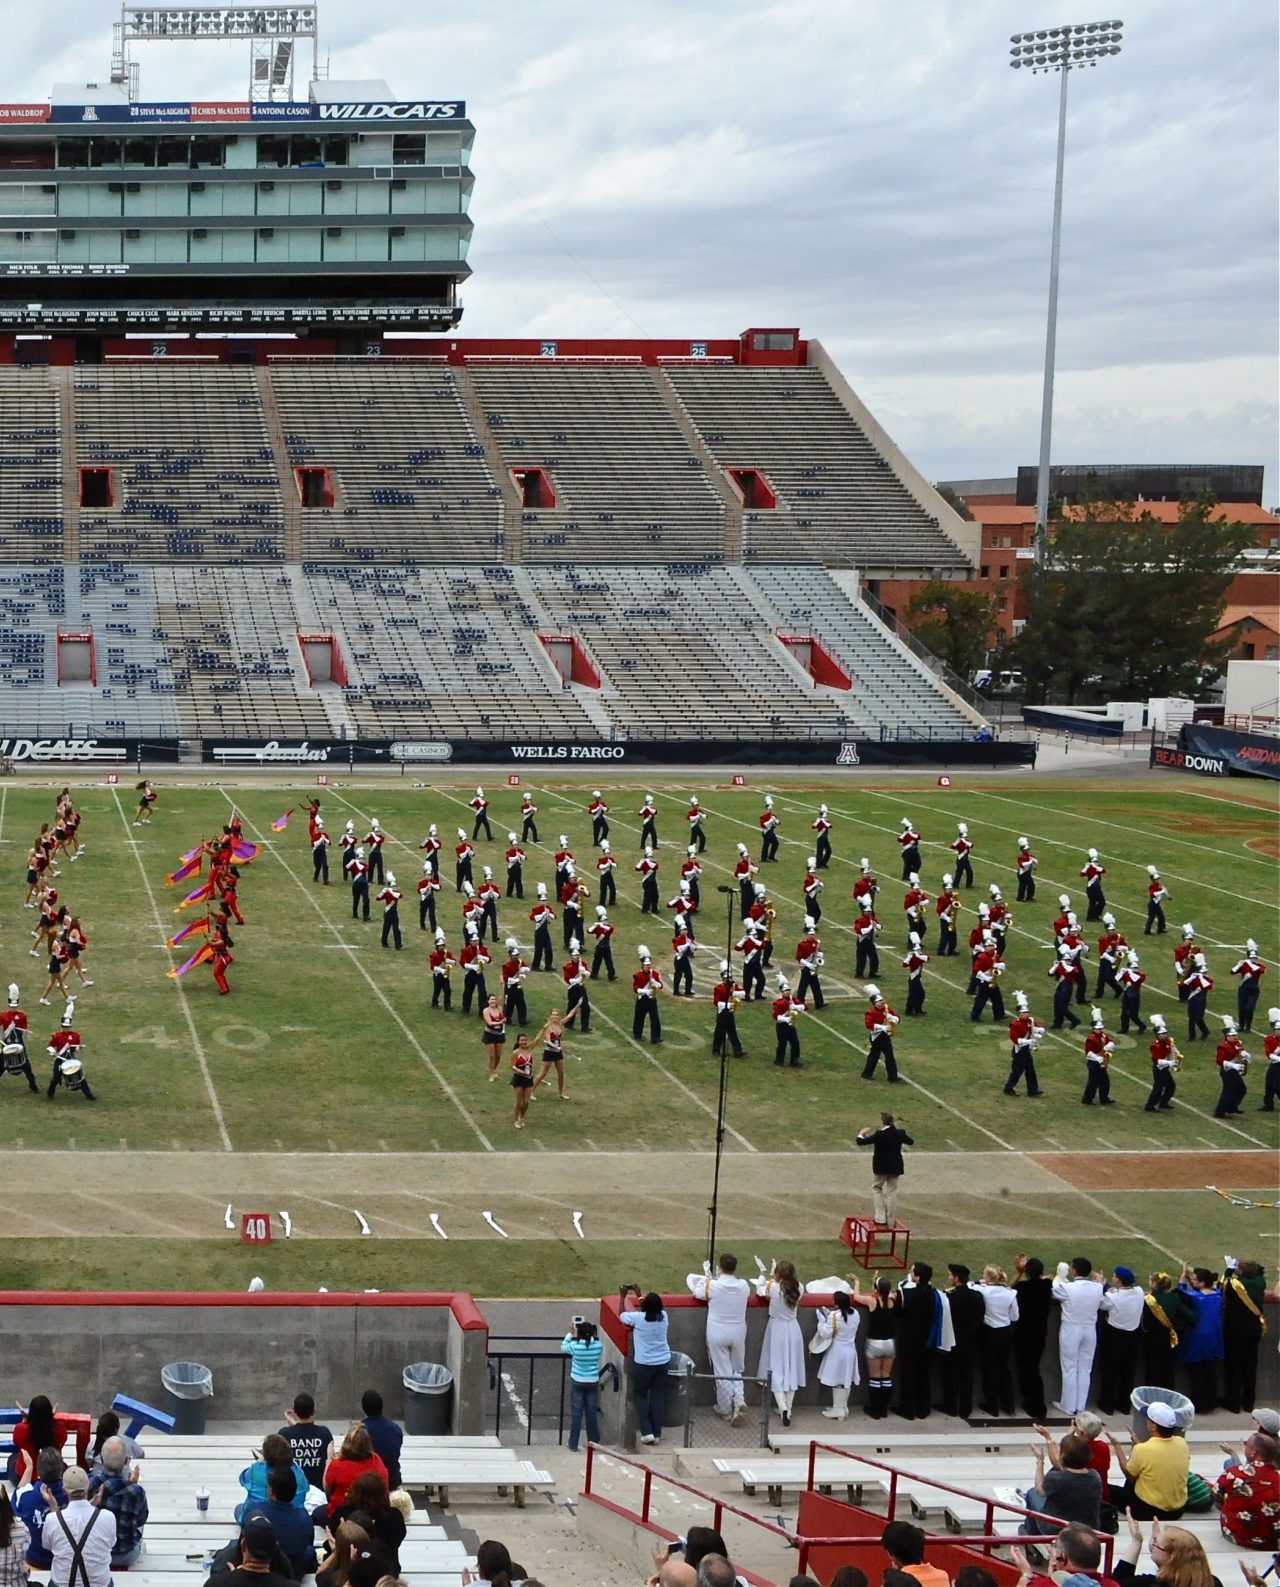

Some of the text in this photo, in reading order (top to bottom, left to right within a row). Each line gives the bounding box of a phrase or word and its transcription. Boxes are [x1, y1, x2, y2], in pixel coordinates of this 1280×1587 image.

[11, 109, 44, 117] WALDROP
[140, 108, 154, 116] STEVE
[156, 108, 190, 116] McLAUGHLIN
[198, 107, 216, 115] CHRIS
[217, 107, 250, 115] McALISTER
[257, 107, 285, 115] ANTOINE
[287, 107, 309, 115] CASON
[320, 104, 457, 118] WILDCATS
[153, 346, 166, 356] 22
[367, 346, 380, 356] 23
[542, 347, 555, 357] 24
[692, 347, 705, 358] 25
[511, 747, 624, 758] WELLS FARGO
[837, 743, 859, 764] A
[246, 1218, 266, 1239] 40
[290, 1439, 322, 1448] BAND
[296, 1449, 318, 1458] DAY
[293, 1458, 321, 1467] STAFF
